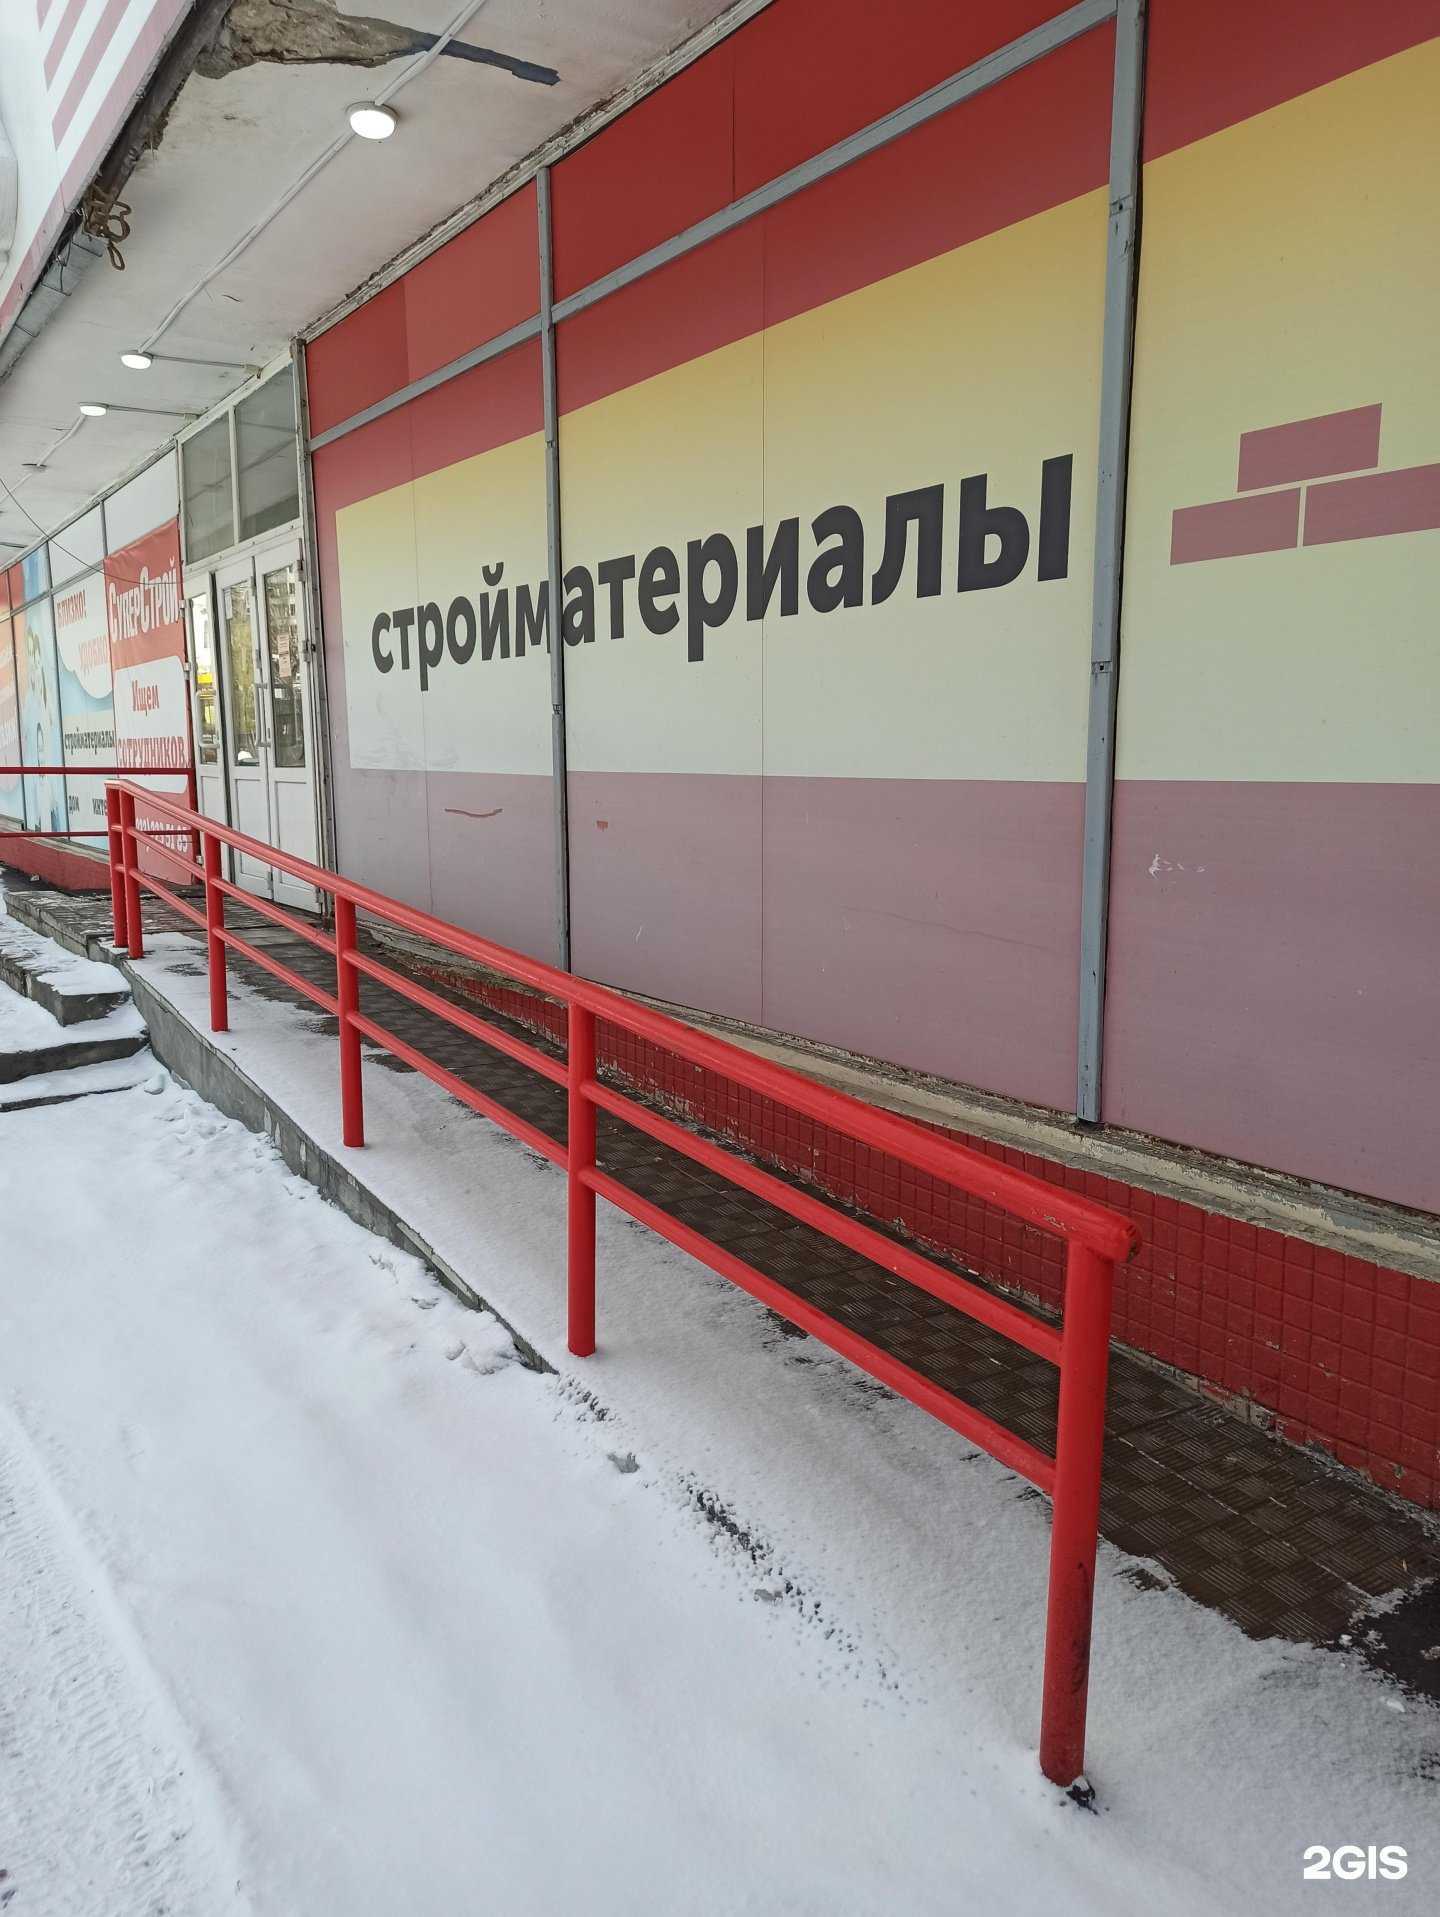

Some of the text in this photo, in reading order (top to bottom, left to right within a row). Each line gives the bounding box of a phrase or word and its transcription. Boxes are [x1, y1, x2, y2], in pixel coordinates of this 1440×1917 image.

[371, 453, 1074, 692] стройматериалы
[131, 679, 160, 717] Ищем
[64, 727, 116, 756] стройматериалы
